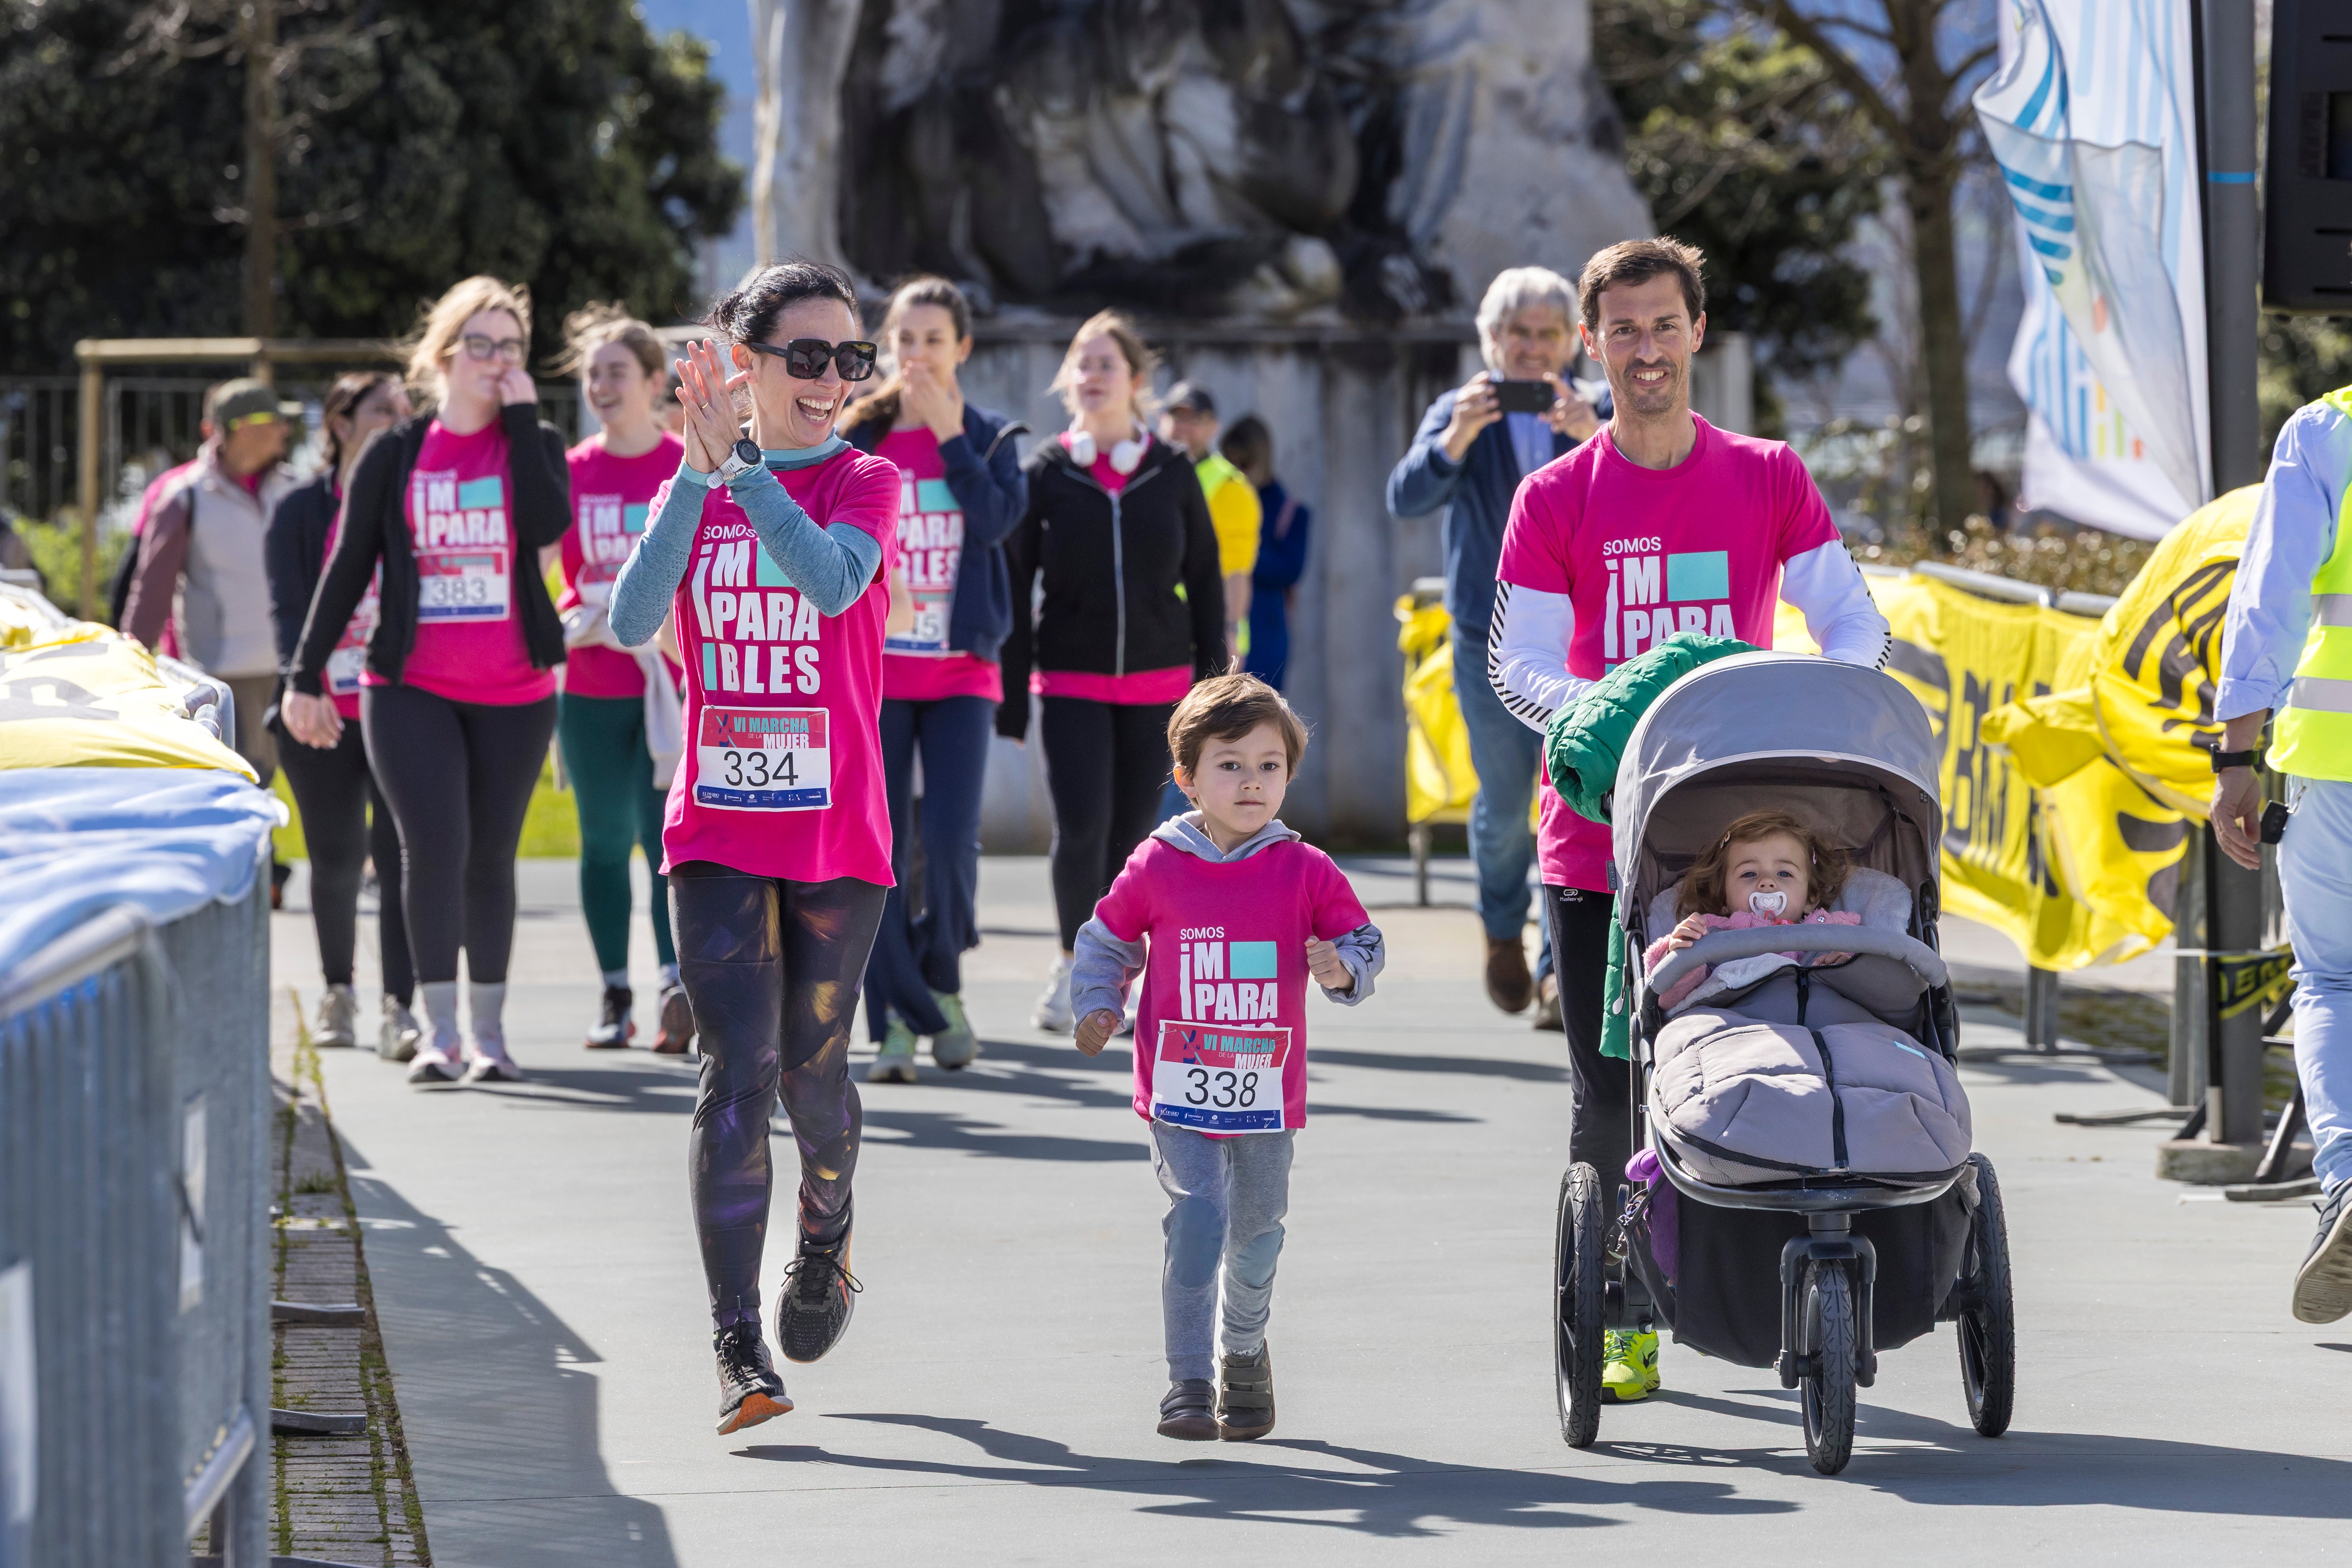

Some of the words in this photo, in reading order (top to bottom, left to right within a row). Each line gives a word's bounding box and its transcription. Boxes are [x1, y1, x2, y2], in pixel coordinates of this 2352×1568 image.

[428, 511, 508, 546] PARA
[702, 524, 757, 540] SOMOS
[595, 535, 639, 561] PA
[1603, 537, 1661, 556] SOMOS
[432, 577, 488, 605] 383
[711, 592, 820, 640] PARA
[734, 717, 746, 732] VI
[749, 717, 809, 733] MARCHA
[763, 733, 809, 749] MUJER
[724, 751, 799, 787] 334
[1180, 926, 1224, 940] SOMOS
[1195, 983, 1278, 1020] PARA
[1203, 1034, 1217, 1050] VI
[1220, 1036, 1275, 1053] MARCHA
[1235, 1054, 1272, 1070] MUJER
[1185, 1068, 1258, 1108] 338
